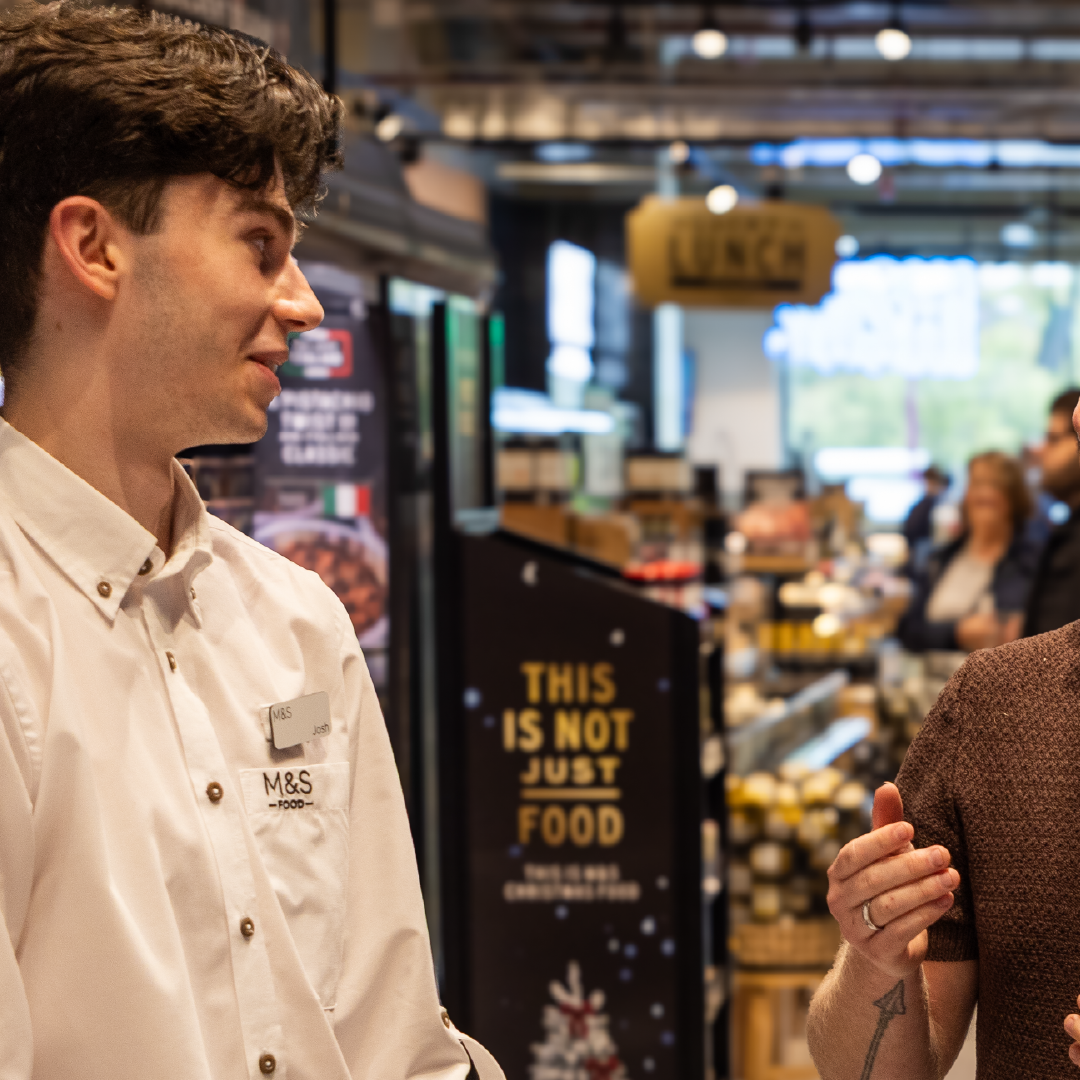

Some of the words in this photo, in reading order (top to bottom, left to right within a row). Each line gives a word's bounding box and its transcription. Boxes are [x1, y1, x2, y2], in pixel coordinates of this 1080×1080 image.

[667, 230, 806, 275] LUNCH
[520, 661, 616, 704] THIS
[273, 706, 292, 721] M&S
[313, 723, 330, 735] Josh
[503, 708, 544, 752] IS
[554, 708, 635, 752] NOT
[263, 770, 313, 795] M&S
[519, 756, 621, 785] JUST
[278, 799, 305, 810] FOOD
[517, 804, 624, 846] FOOD
